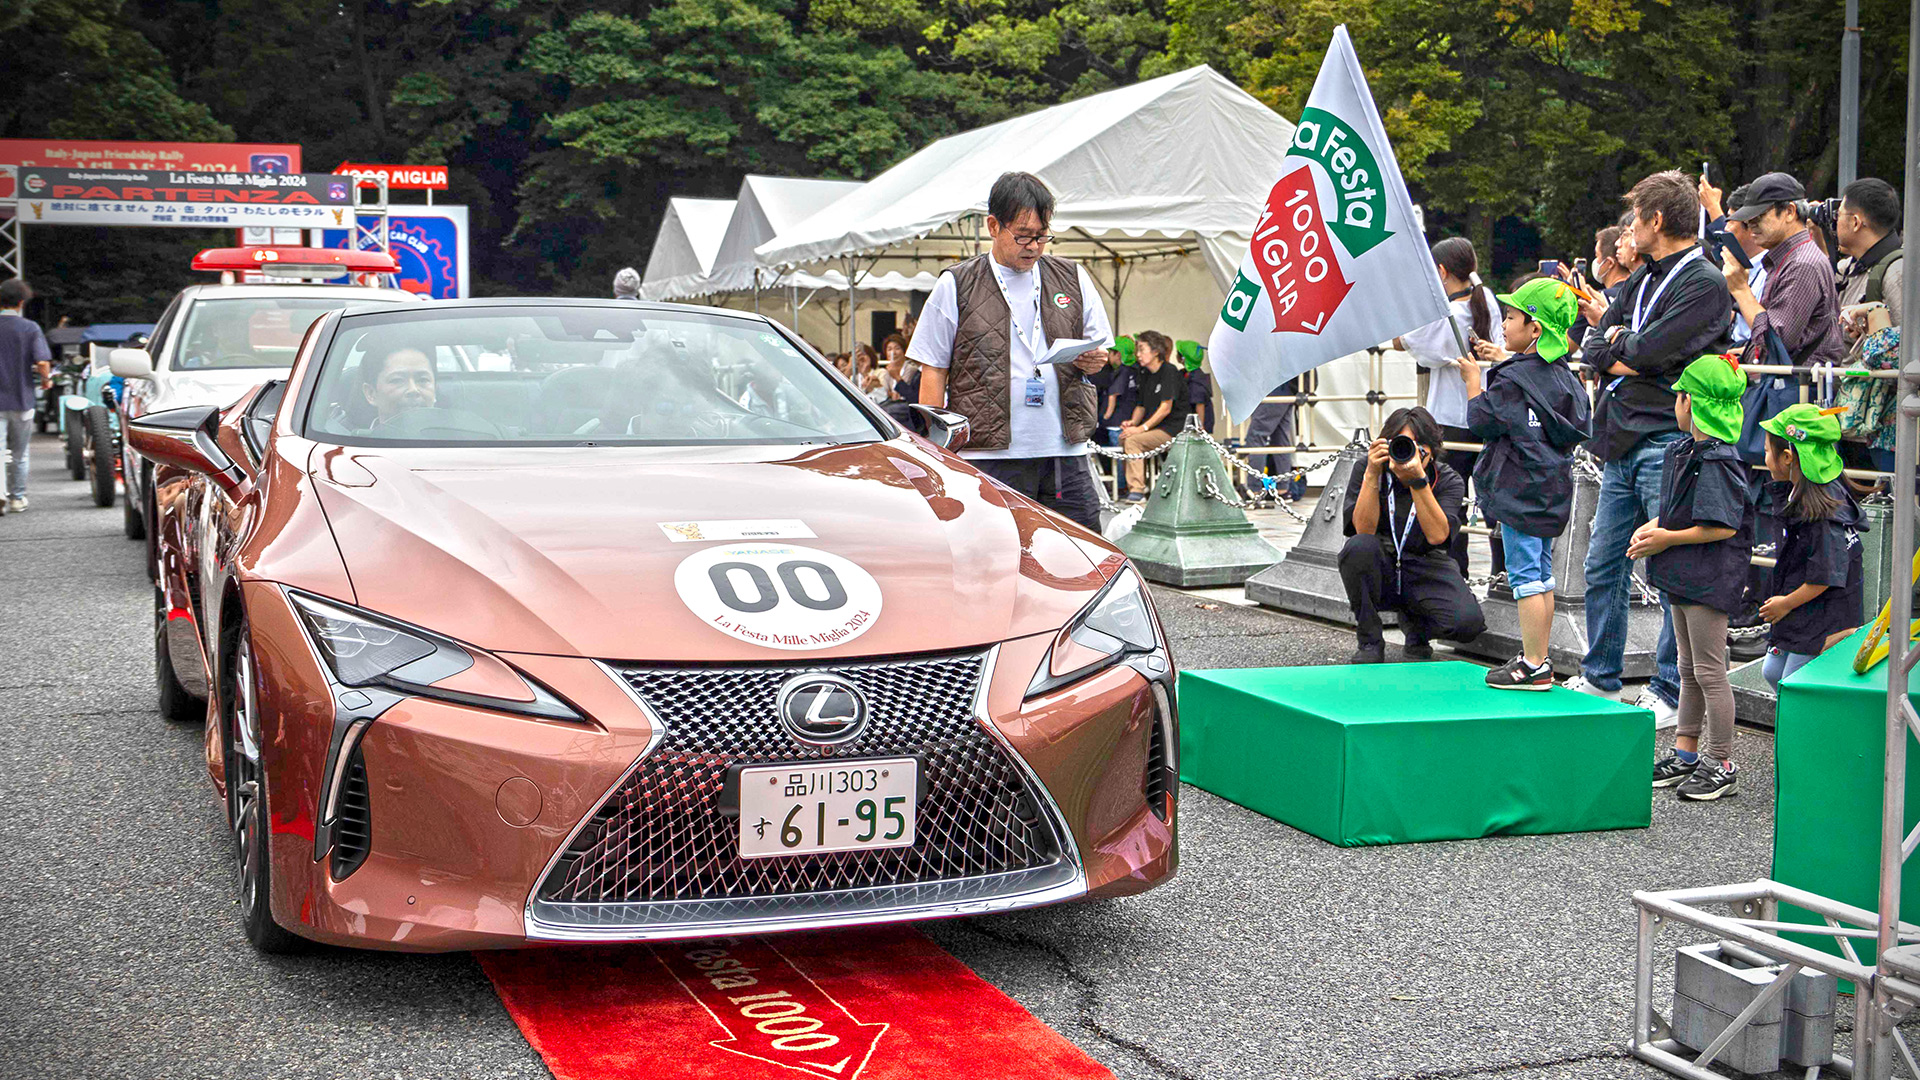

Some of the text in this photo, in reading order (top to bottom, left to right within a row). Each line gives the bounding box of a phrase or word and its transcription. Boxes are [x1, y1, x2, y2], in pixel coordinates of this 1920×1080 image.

[104, 150, 157, 162] Friendship
[159, 151, 184, 162] Rally
[53, 185, 321, 204] PARTENZA
[169, 172, 307, 188] La Festa Mille Miglia 2024
[391, 171, 447, 184] MIGLIA
[1320, 126, 1377, 228] Festa
[390, 231, 408, 242] CAR
[407, 236, 429, 254] CLUB
[1285, 189, 1328, 283] 1000
[708, 560, 848, 613] 00
[714, 609, 871, 646] La Festa Mille Miglia 2024
[752, 796, 906, 848] す 61-95
[727, 990, 840, 1051] 1000
